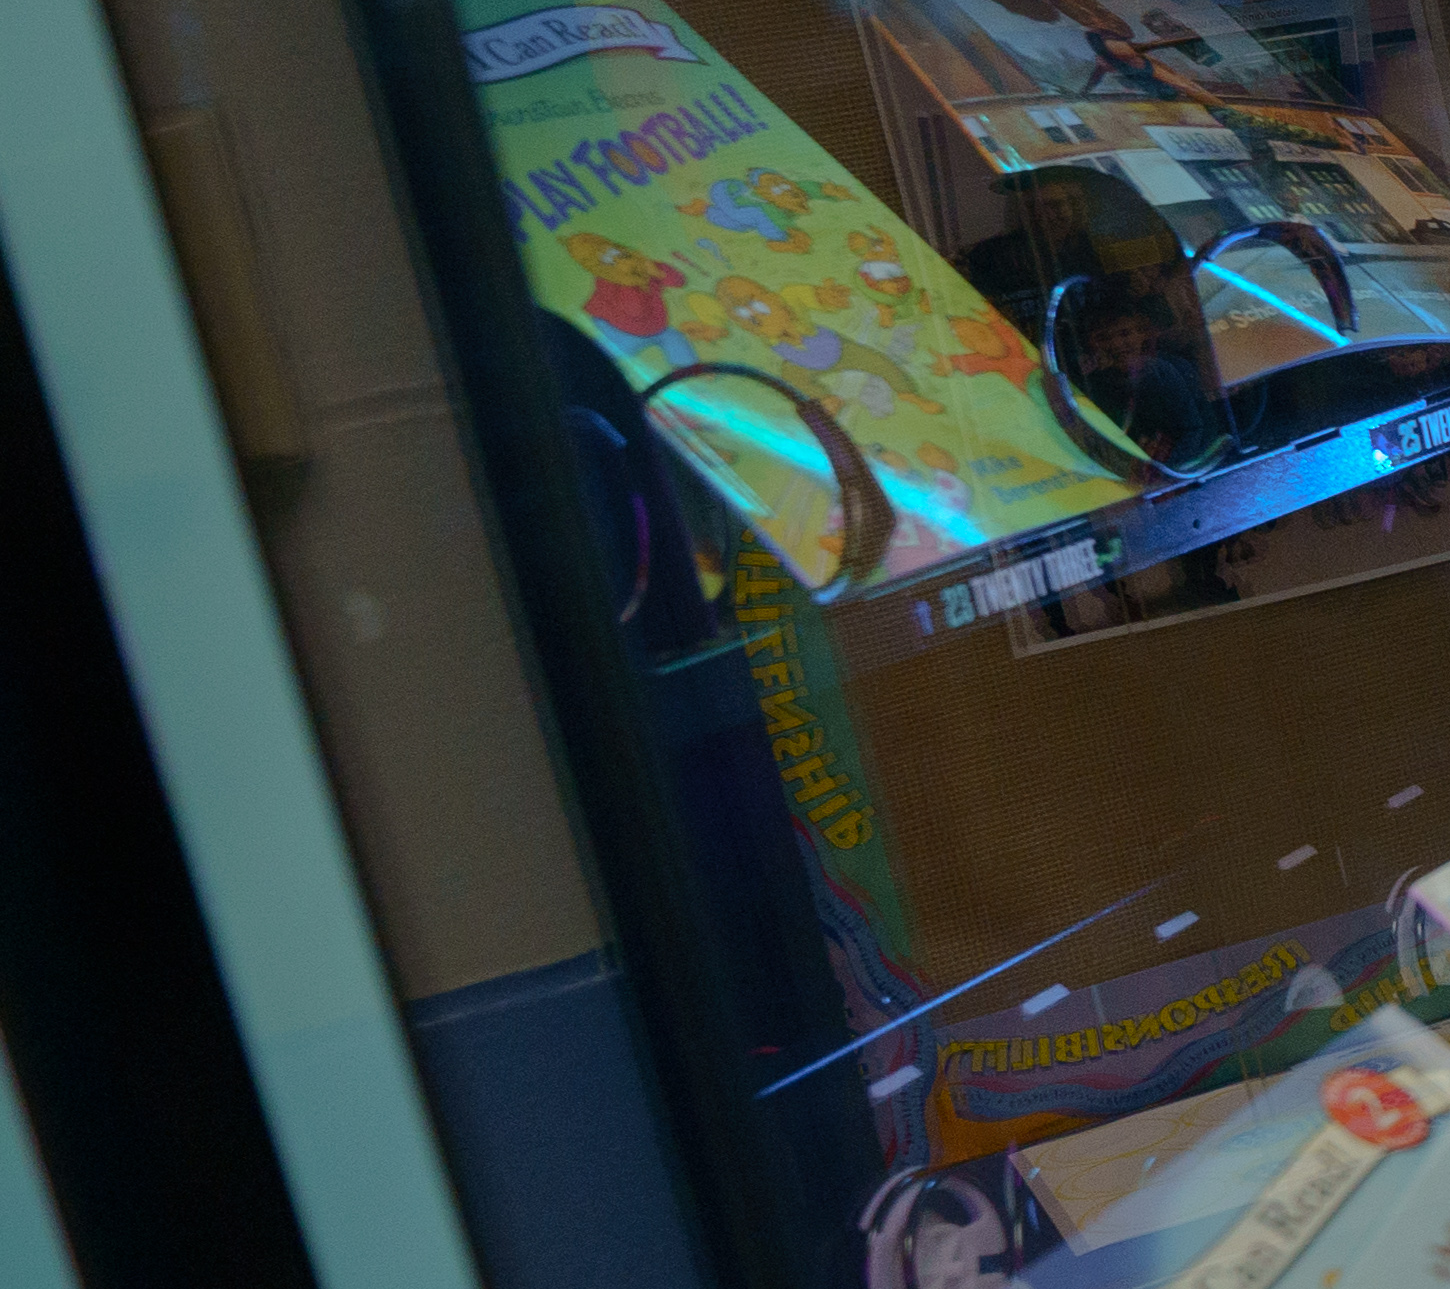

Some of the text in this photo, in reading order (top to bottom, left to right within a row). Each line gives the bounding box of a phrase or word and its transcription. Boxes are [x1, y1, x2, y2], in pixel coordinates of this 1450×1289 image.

[483, 17, 553, 68] Can
[541, 11, 650, 49] Read!
[569, 80, 769, 198] FOOTBALL!
[1252, 1139, 1358, 1243] Read!
